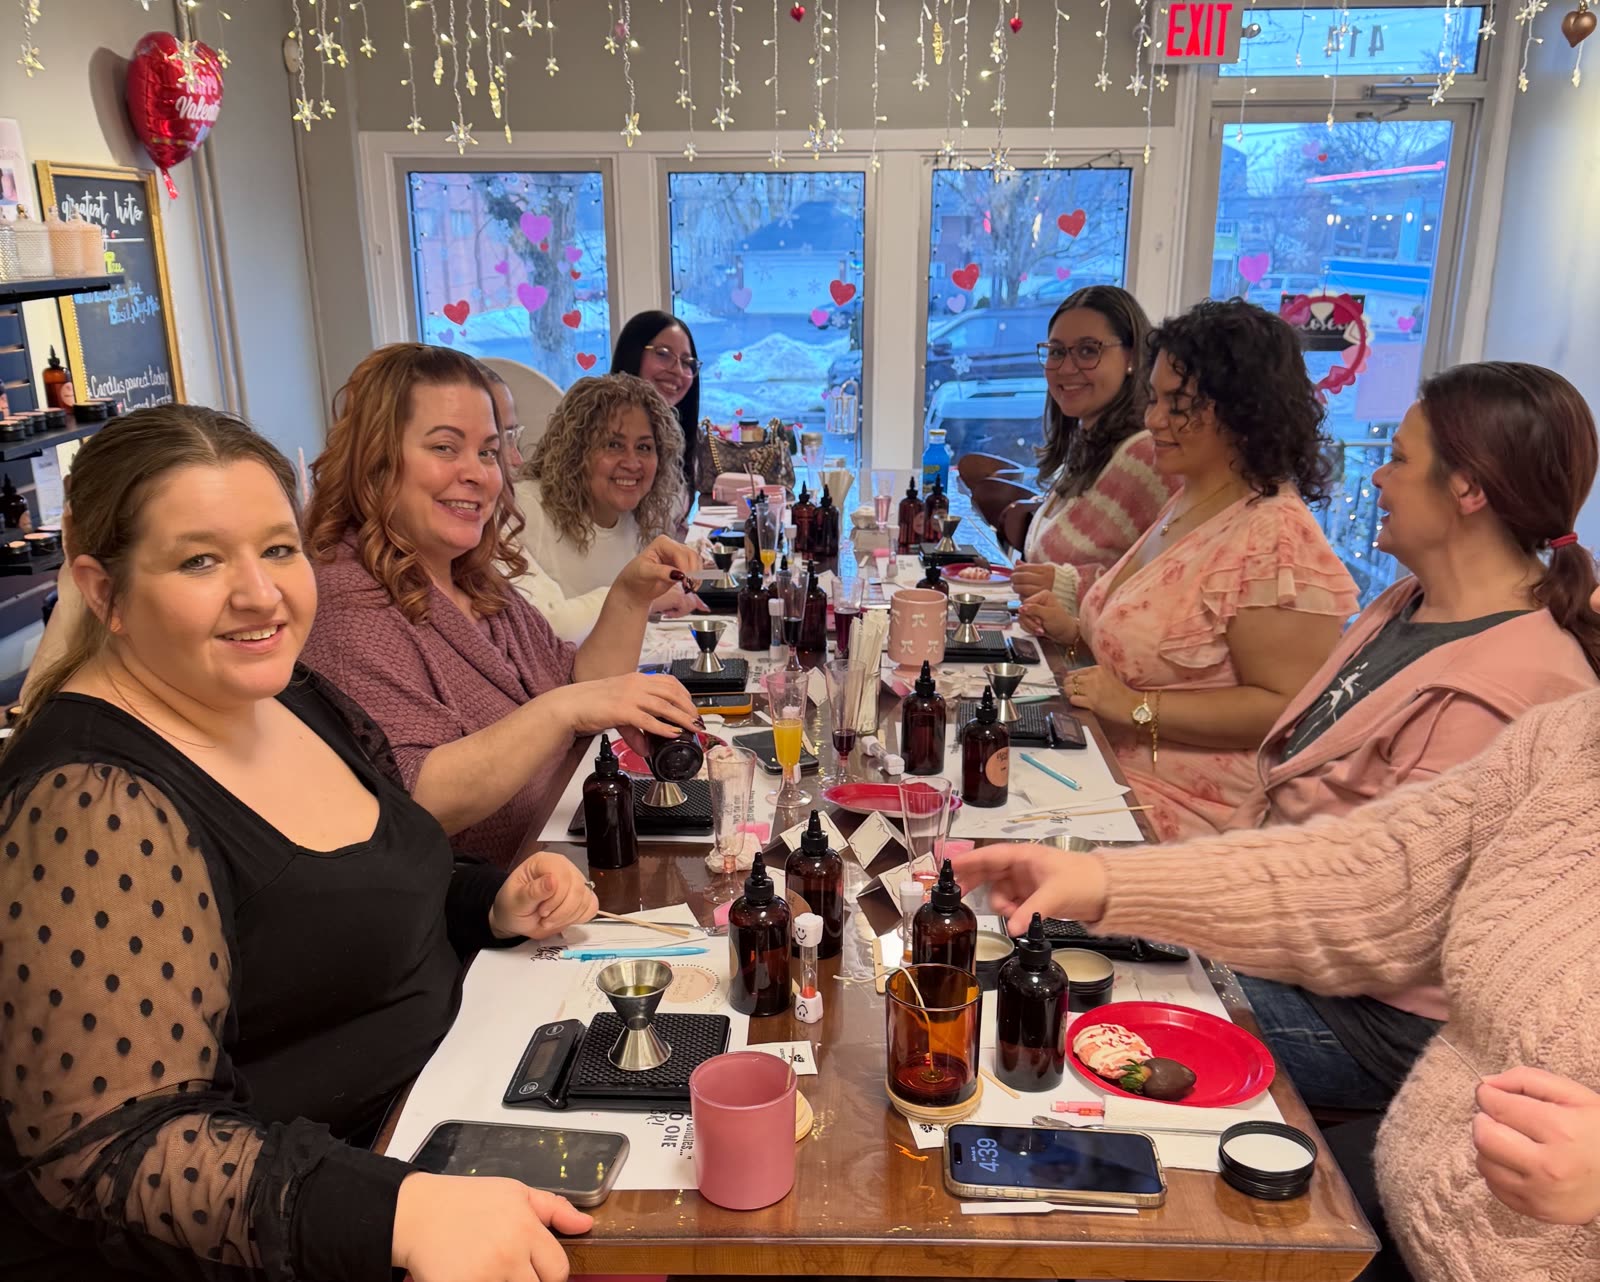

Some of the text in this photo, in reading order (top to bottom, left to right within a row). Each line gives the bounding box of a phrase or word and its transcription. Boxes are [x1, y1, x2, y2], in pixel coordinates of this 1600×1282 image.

[1166, 3, 1233, 57] EXIT
[114, 190, 144, 226] hits
[90, 375, 126, 398] Candles
[661, 1124, 681, 1148] ONE
[976, 1138, 1000, 1173] 4:39
